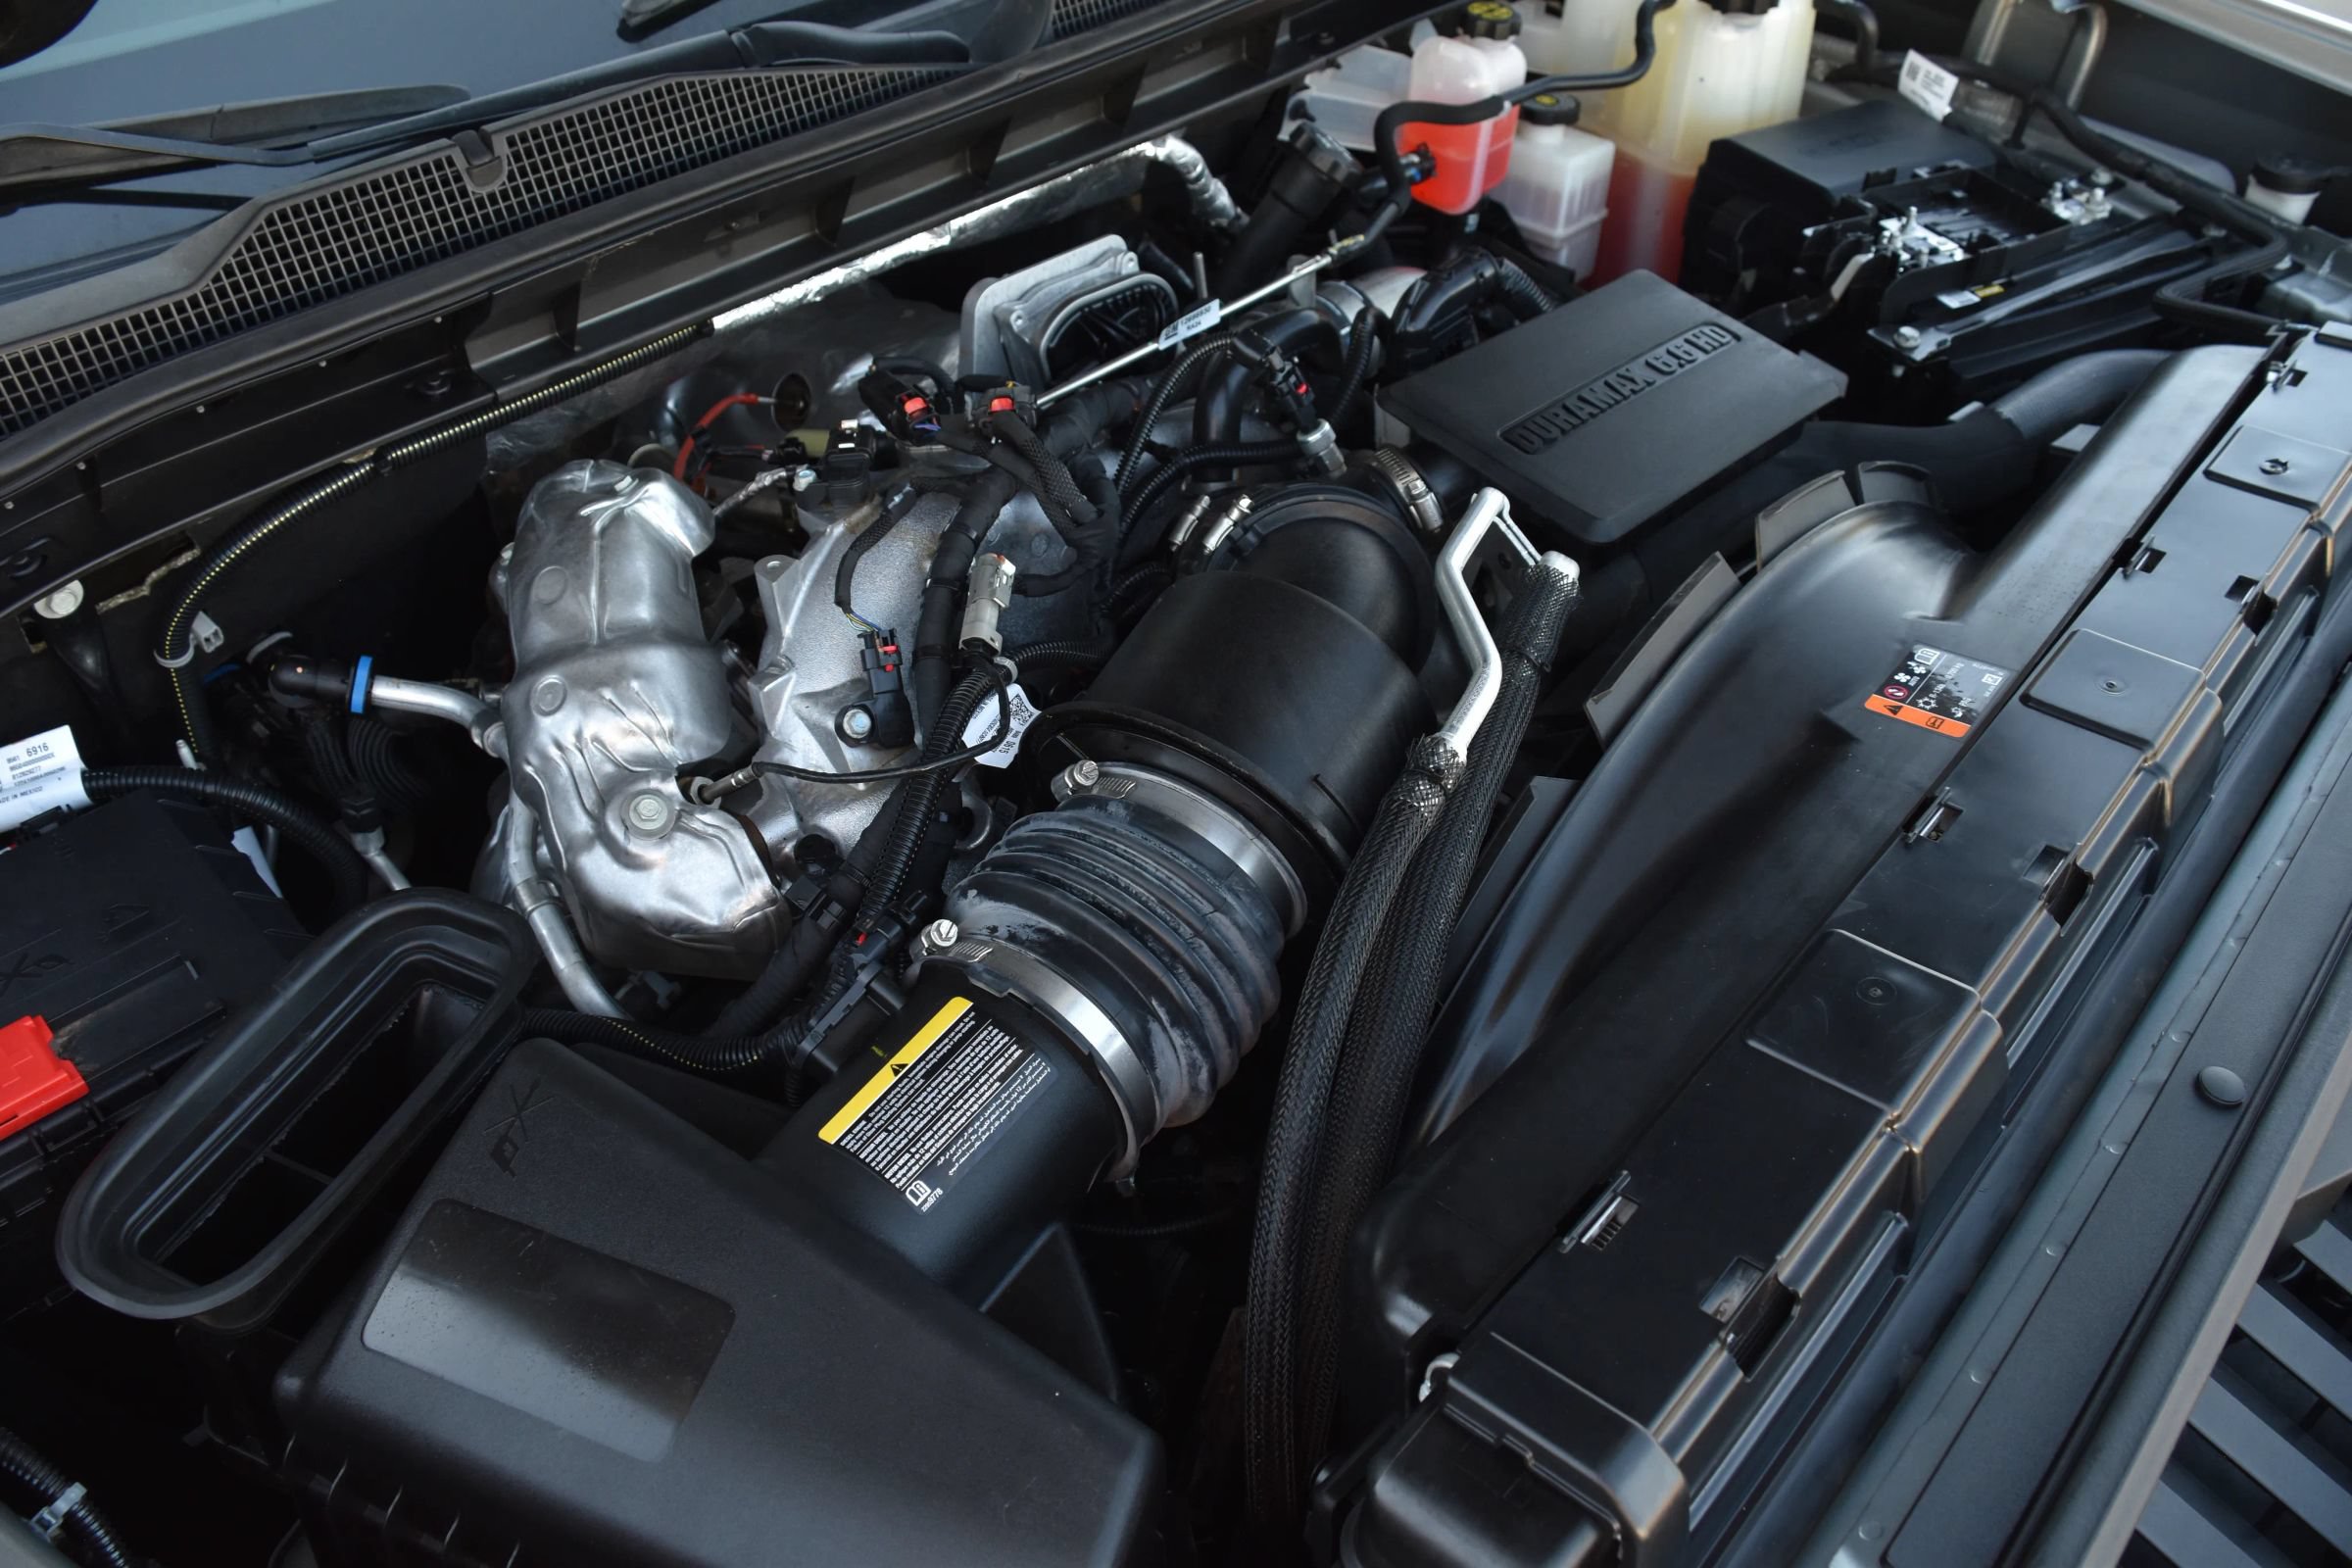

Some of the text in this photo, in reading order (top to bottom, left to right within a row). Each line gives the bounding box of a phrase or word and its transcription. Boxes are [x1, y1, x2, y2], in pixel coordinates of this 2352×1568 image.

[1506, 324, 1734, 455] DURAMAX 6.6 HD
[25, 742, 50, 758] 6916
[20, 786, 43, 796] MEXICO
